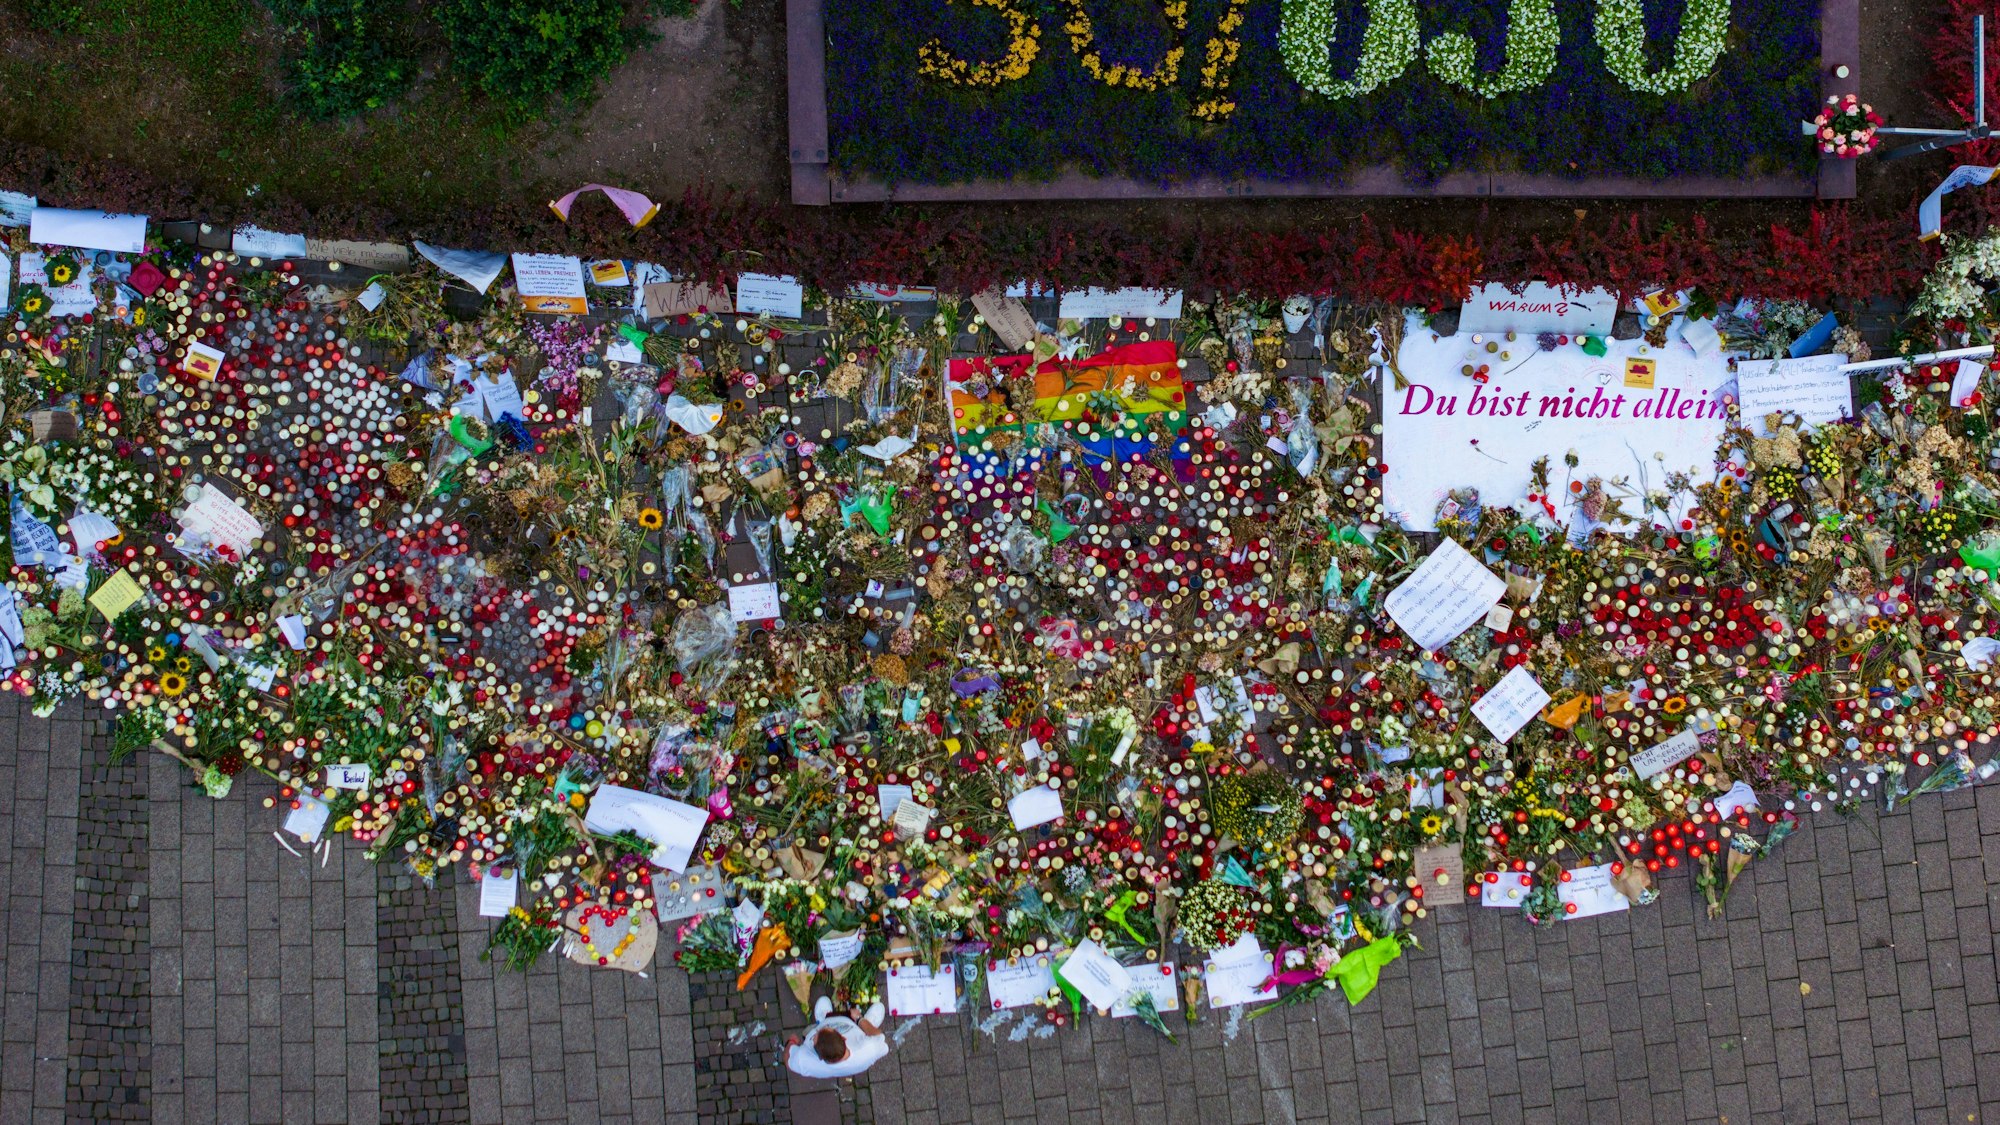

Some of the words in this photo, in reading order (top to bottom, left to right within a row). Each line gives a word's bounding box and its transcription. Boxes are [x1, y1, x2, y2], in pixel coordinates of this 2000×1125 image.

[307, 240, 329, 254] Wie
[1489, 301, 1568, 317] WARUM?
[1399, 384, 1457, 416] Du
[1467, 384, 1531, 417] bist
[1539, 386, 1626, 419] nicht
[1632, 748, 1655, 763] NICHT
[1660, 742, 1670, 751] IN
[1642, 741, 1686, 766] UNSEREM
[1662, 744, 1697, 765] NAMEN
